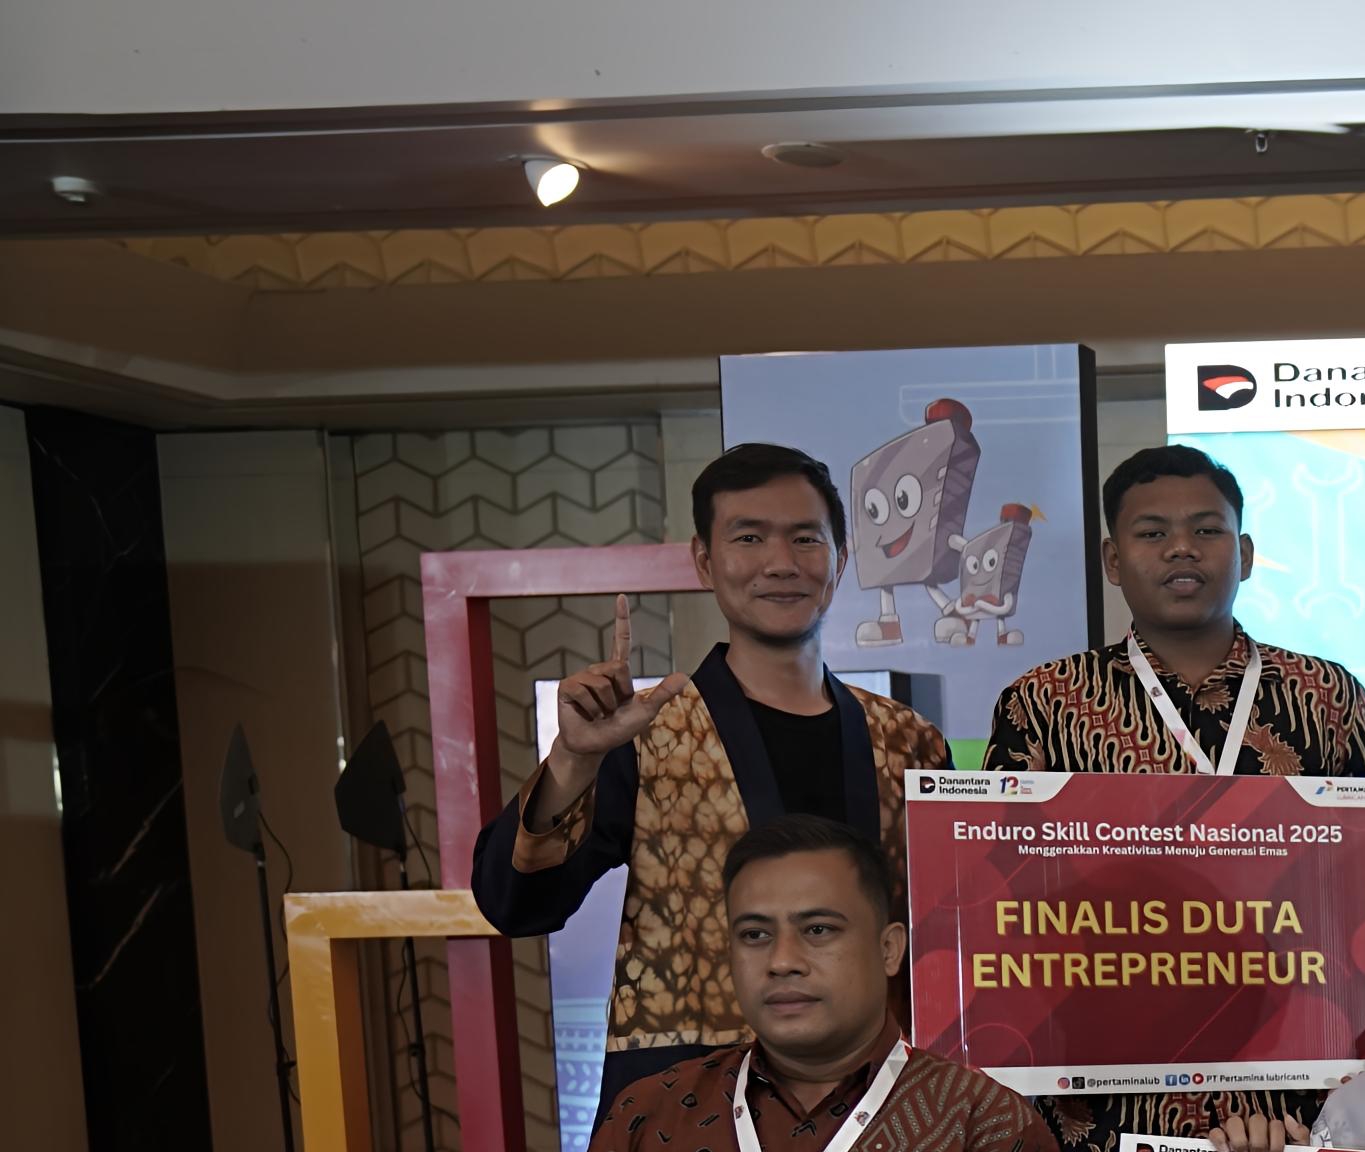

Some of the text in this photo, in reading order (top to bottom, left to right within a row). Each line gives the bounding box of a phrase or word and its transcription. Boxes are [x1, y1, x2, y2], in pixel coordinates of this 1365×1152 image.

[954, 821, 1342, 842] Enduro Skill Contest Nasional 2025
[1019, 845, 1287, 857] Menggerakkan Kreativitas Menuju Generasi Emas
[997, 901, 1303, 935] FINALIS DUTA
[973, 951, 1327, 987] ENTREPRENEUR
